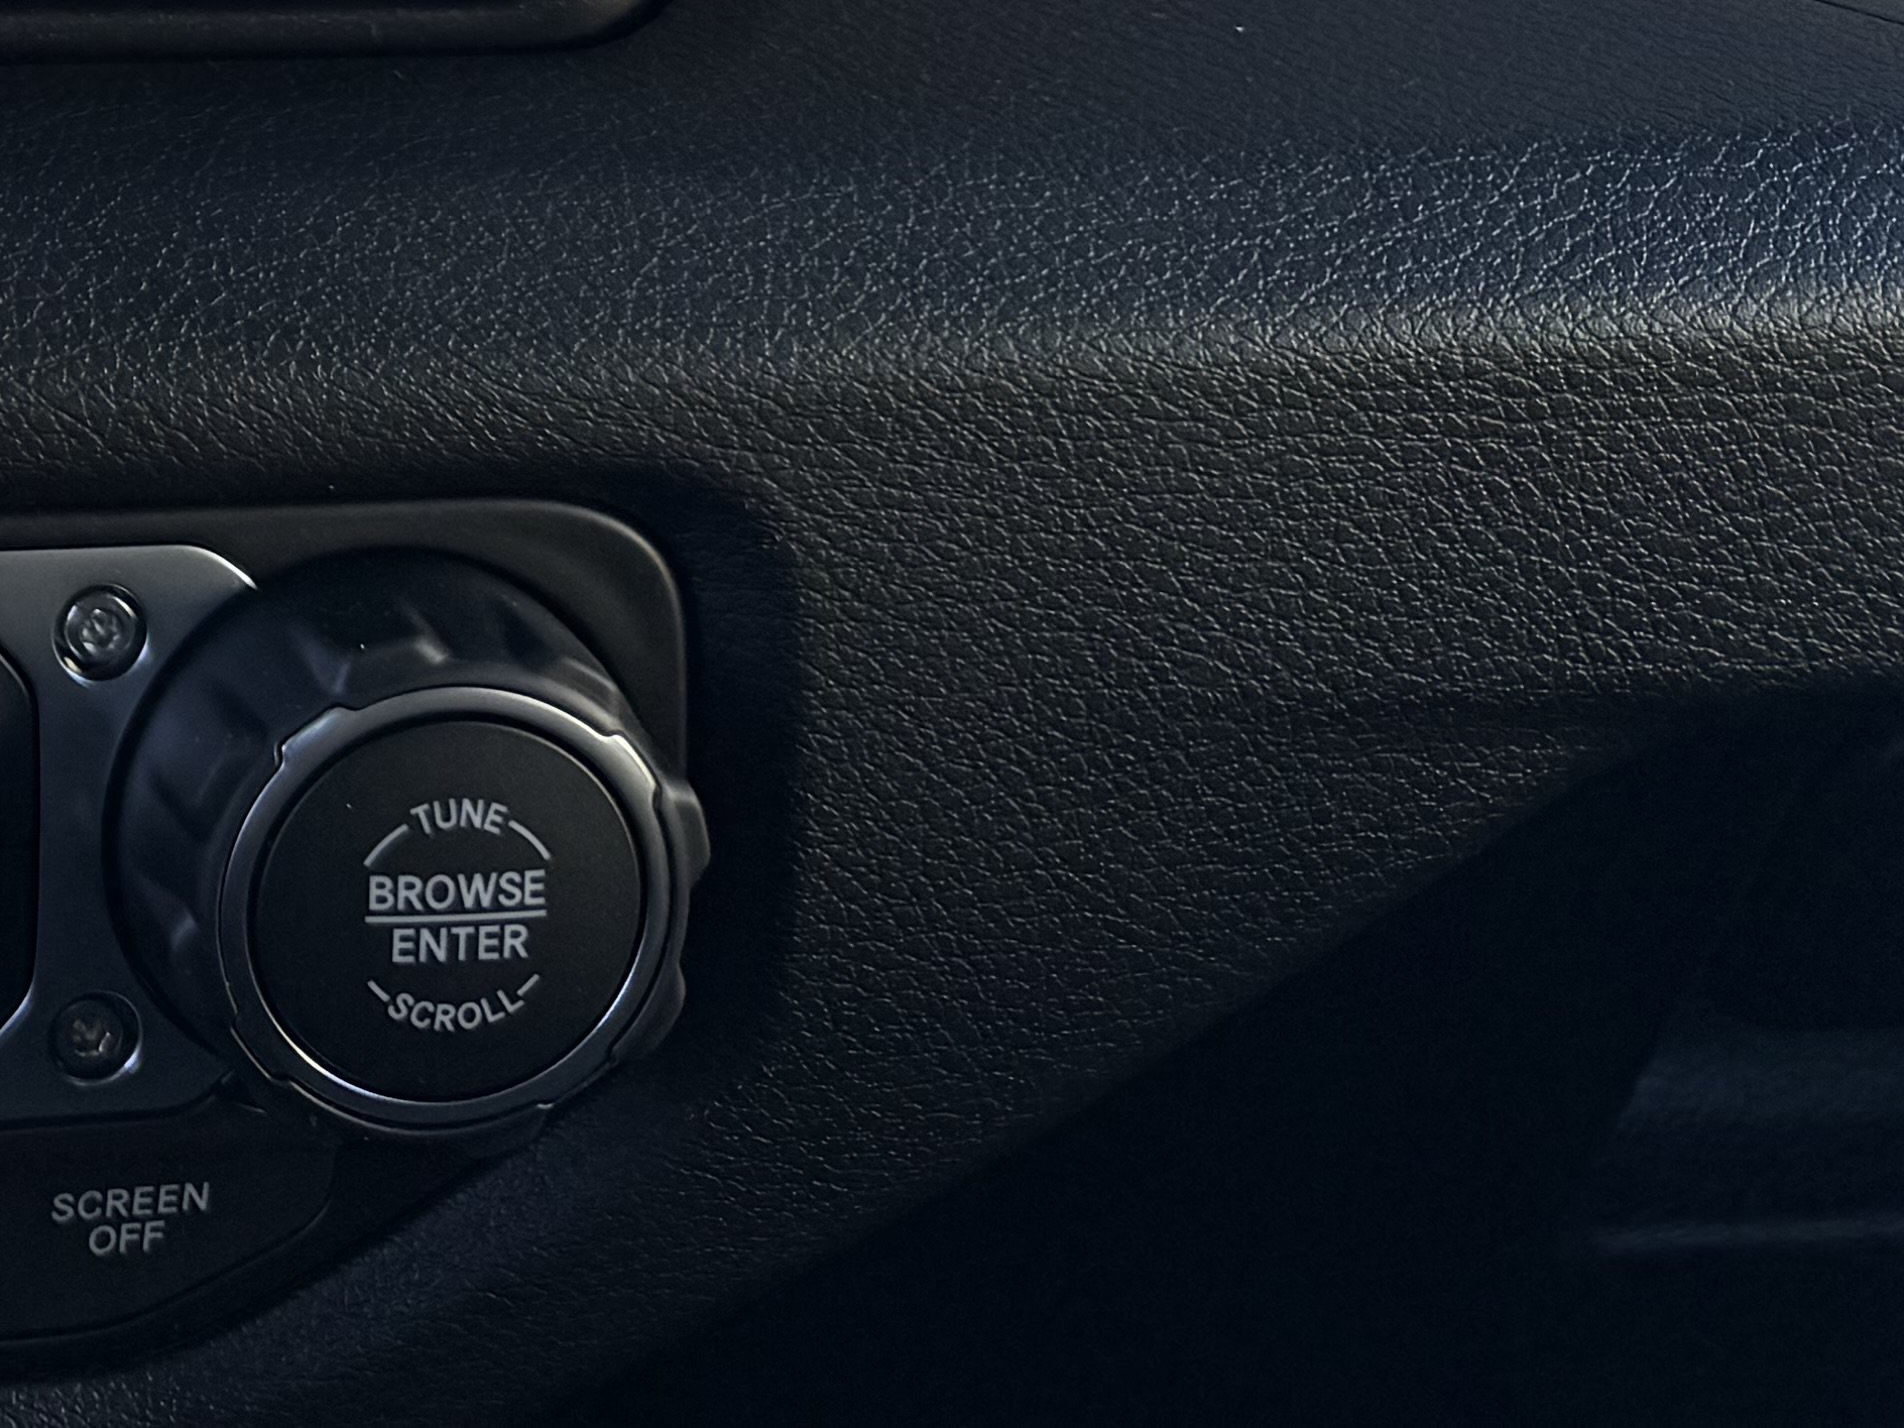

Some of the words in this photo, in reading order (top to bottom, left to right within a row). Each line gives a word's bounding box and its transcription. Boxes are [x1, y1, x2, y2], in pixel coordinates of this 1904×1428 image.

[411, 798, 508, 836] TUNE
[369, 869, 546, 911] BROWSE
[392, 924, 529, 964] ENTER
[388, 988, 524, 1032] SCROLL
[52, 1181, 211, 1224] SCREEN
[89, 1220, 164, 1256] OFF
